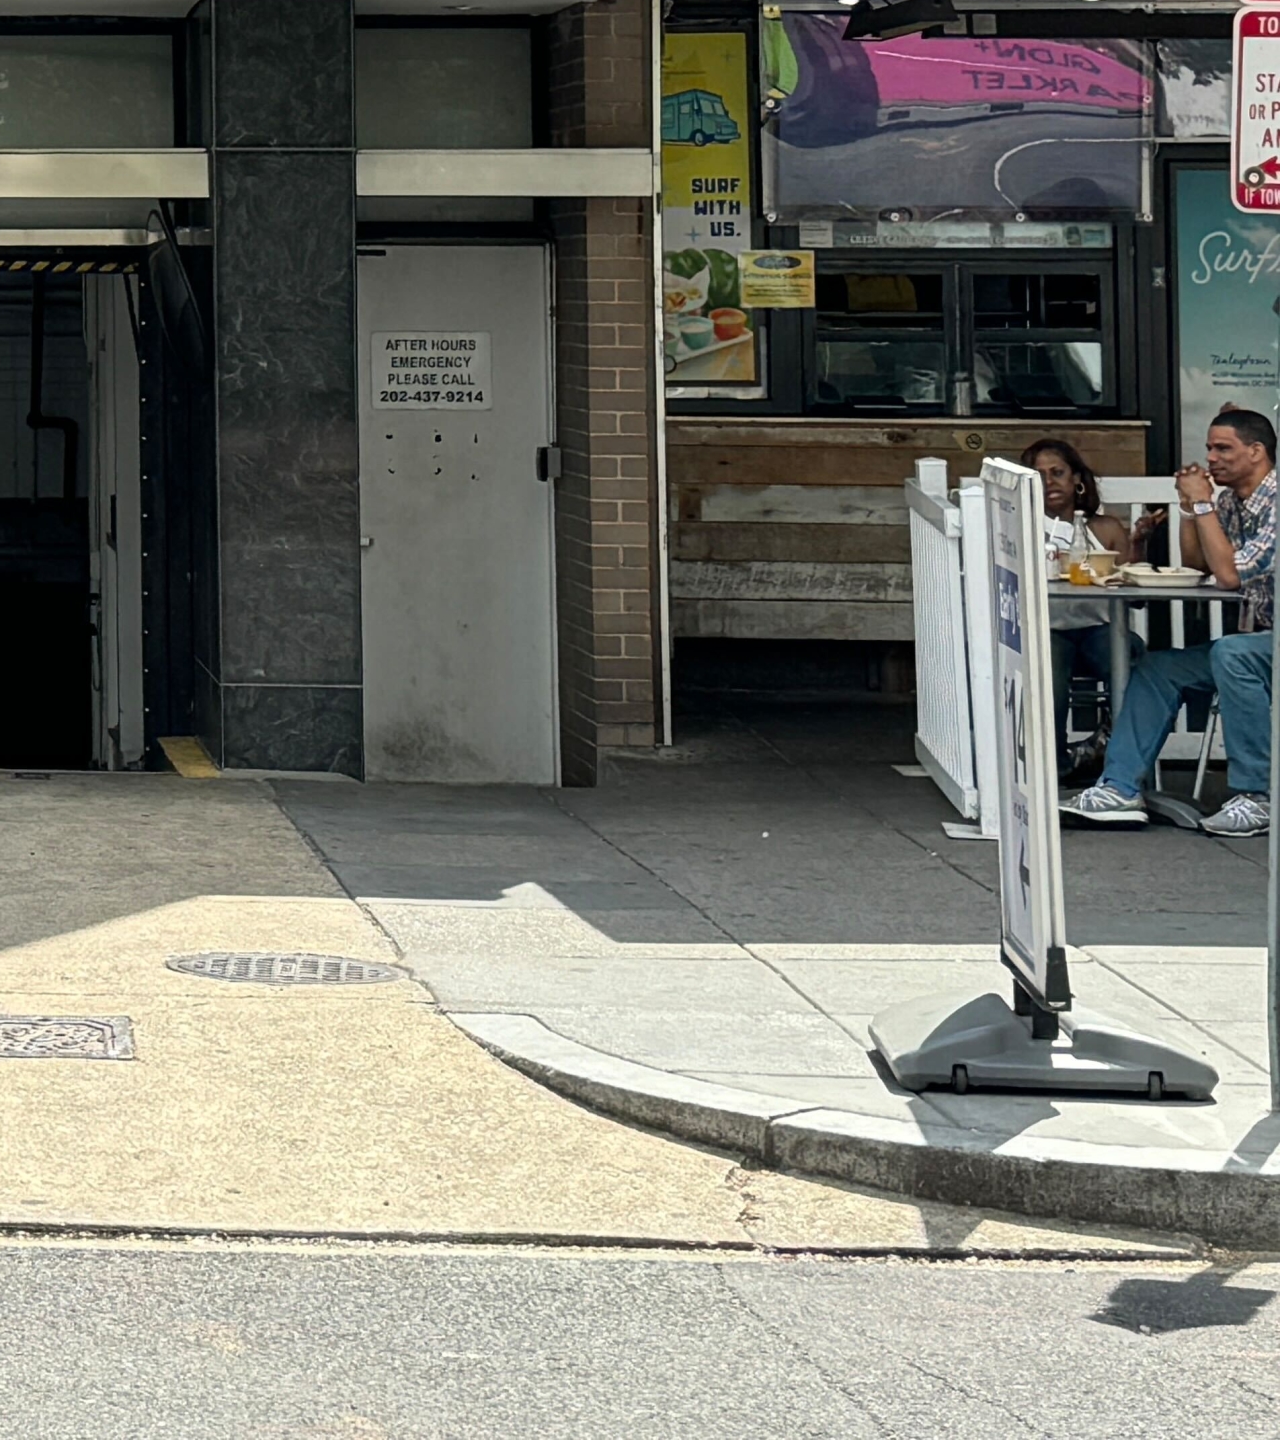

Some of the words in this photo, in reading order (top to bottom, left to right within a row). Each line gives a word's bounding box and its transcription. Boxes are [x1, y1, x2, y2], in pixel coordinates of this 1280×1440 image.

[1258, 17, 1279, 34] TO
[1249, 103, 1266, 120] OR
[1271, 101, 1280, 120] P
[692, 178, 741, 194] SURF
[694, 200, 741, 216] WITH
[710, 222, 741, 237] US.
[385, 340, 427, 351] AFTER
[431, 340, 476, 351] HOURS
[391, 357, 472, 368] EMERGENCY
[388, 374, 439, 385] PLEASE
[441, 374, 475, 385] CALL
[380, 391, 484, 402] 202-437-9214
